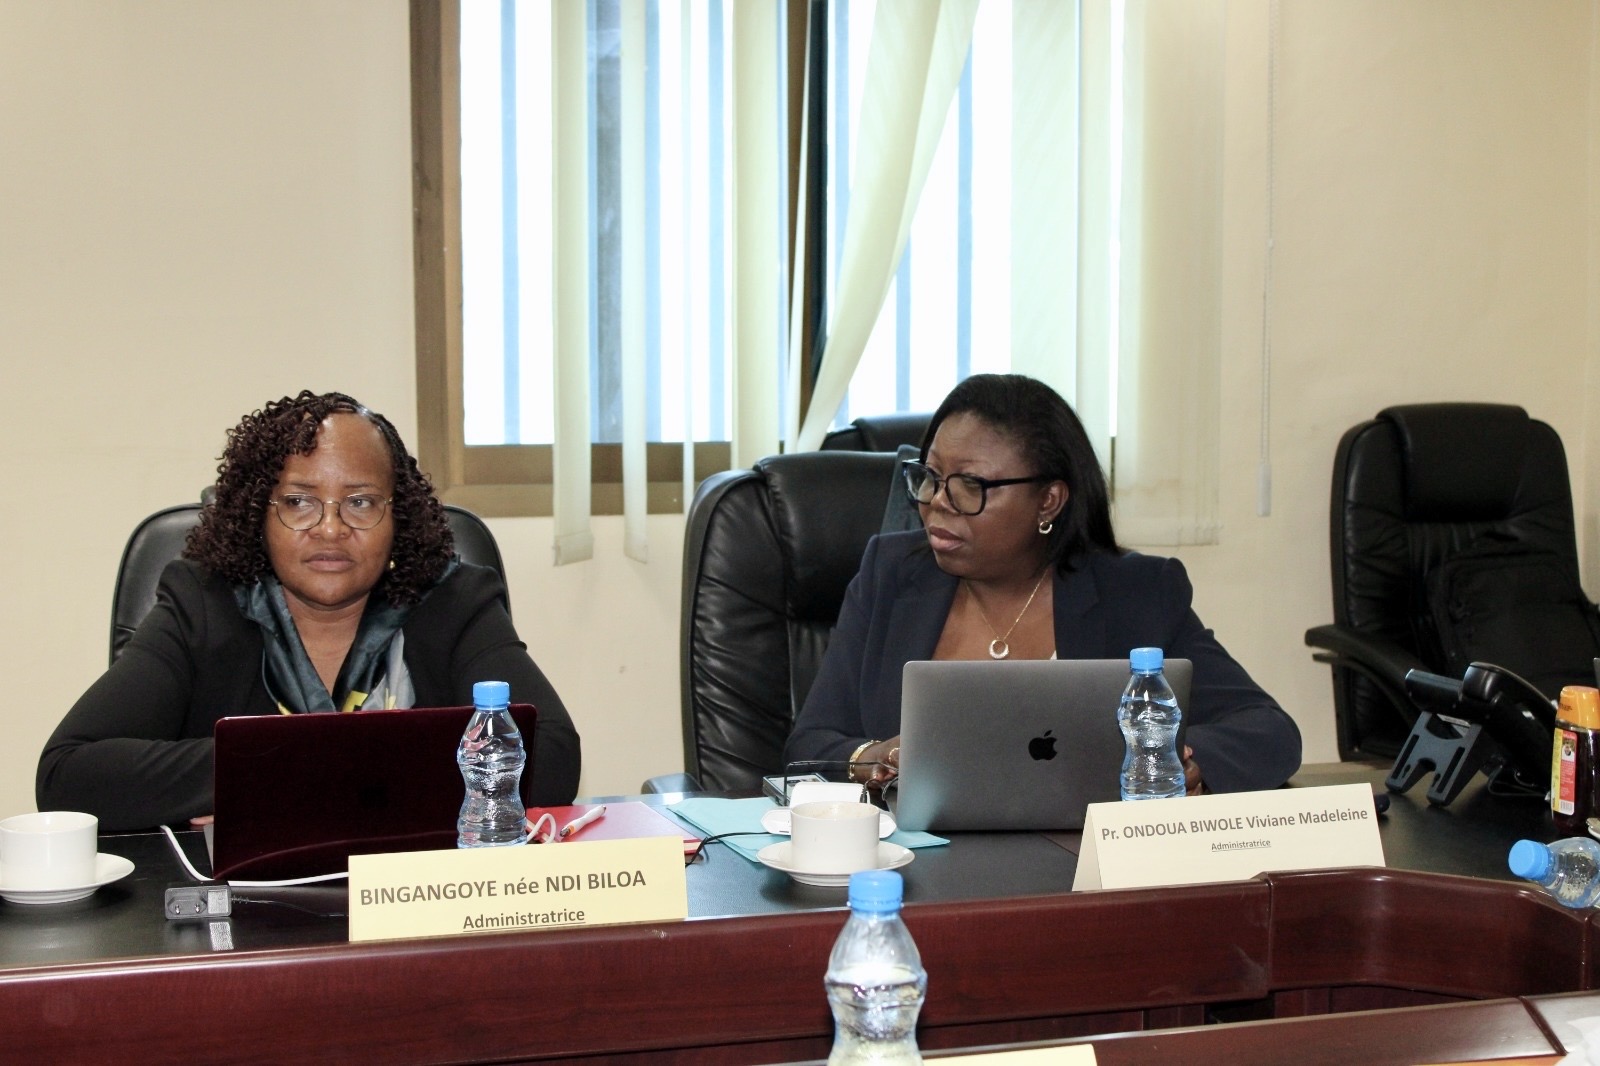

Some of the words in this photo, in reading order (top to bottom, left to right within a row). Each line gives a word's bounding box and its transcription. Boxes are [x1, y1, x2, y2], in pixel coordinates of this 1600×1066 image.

[1101, 827, 1119, 841] Pr.
[1123, 822, 1187, 839] ONDOUA
[1191, 817, 1243, 833] BIWOLE
[1245, 813, 1295, 829] Viviane
[1298, 808, 1368, 825] Madeleine
[1211, 839, 1271, 851] Administratrice
[360, 880, 498, 905] BINGANGOYE
[504, 876, 539, 896] née
[546, 874, 581, 893] NDI
[588, 870, 647, 890] BILOA
[463, 908, 586, 929] Administratrice
